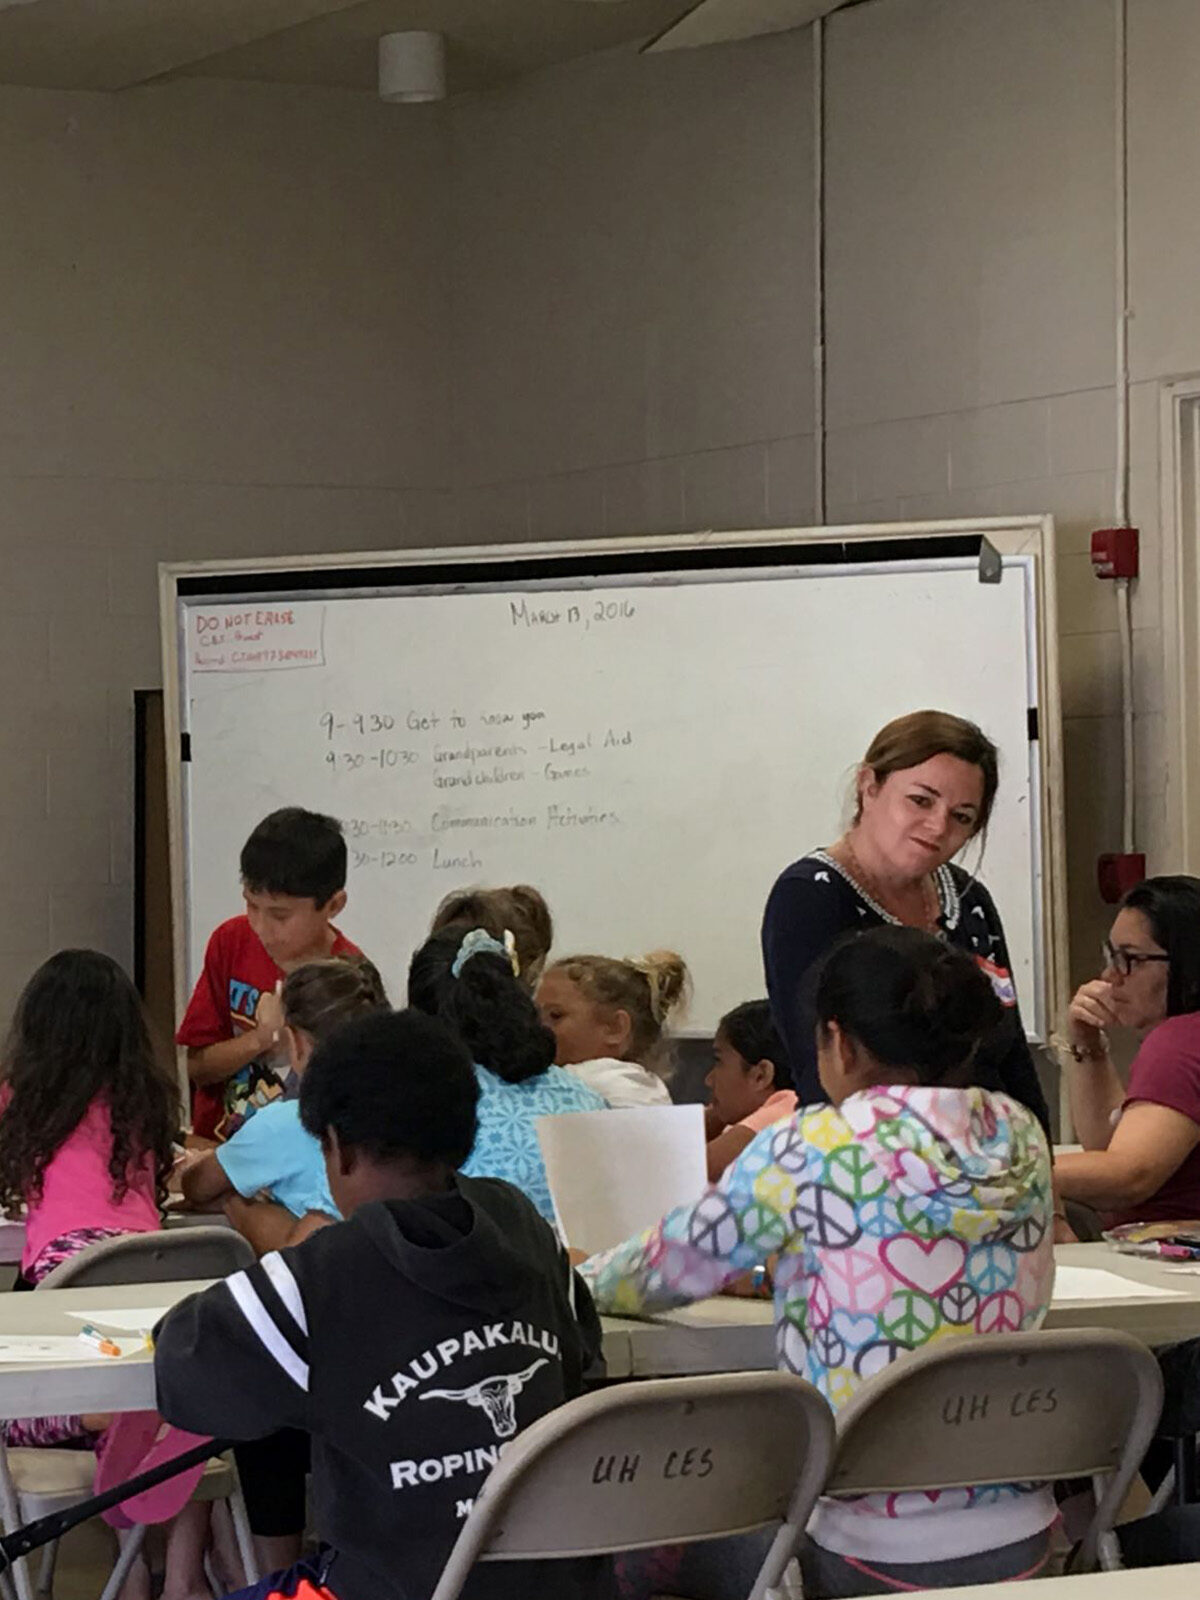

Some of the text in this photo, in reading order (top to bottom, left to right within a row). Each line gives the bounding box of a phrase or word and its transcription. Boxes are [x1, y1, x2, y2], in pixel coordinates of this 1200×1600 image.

[594, 600, 635, 622] 2016
[196, 614, 220, 634] DO
[225, 613, 252, 630] NOT
[406, 709, 440, 731] Get
[603, 728, 633, 749] Aid
[432, 848, 483, 870] Lunch
[363, 1321, 562, 1421] KAUPAKALU
[941, 1395, 988, 1425] UH
[389, 1444, 503, 1489] ROPIN
[591, 1454, 637, 1485] UH
